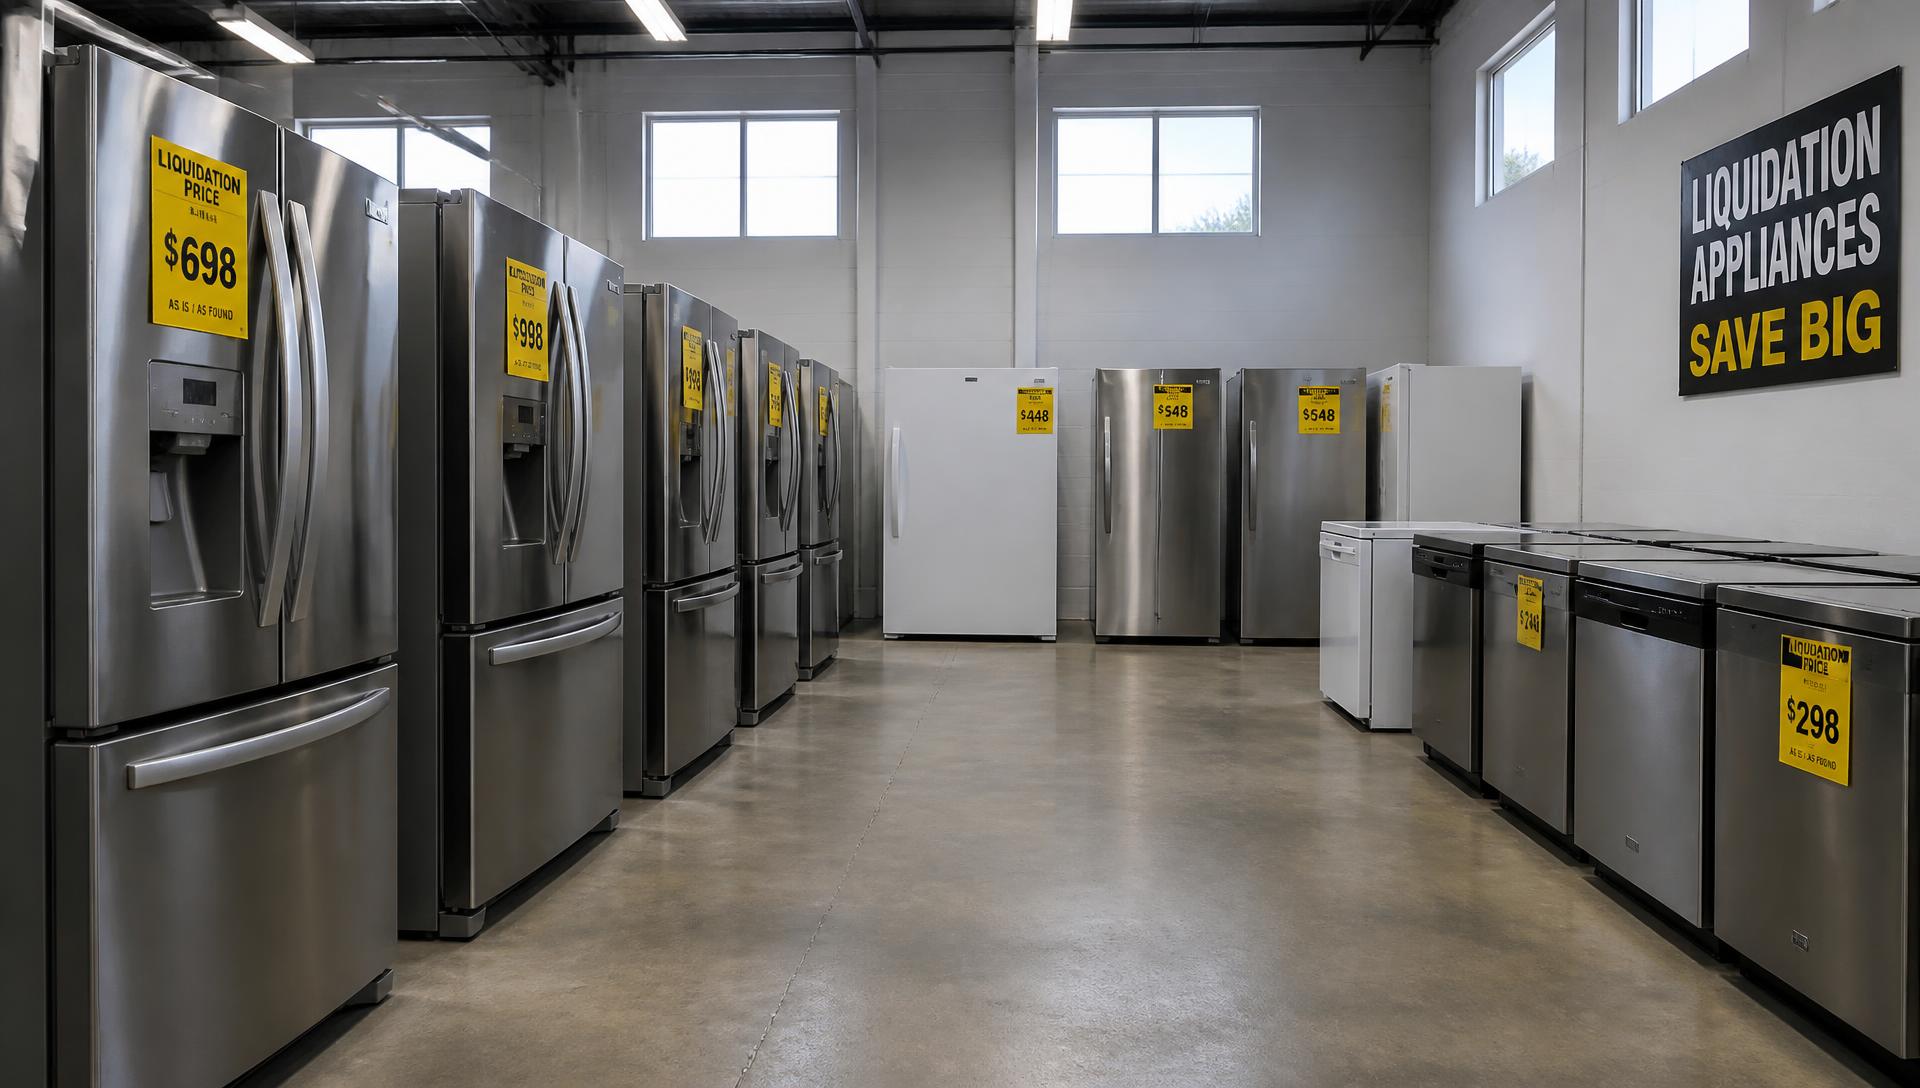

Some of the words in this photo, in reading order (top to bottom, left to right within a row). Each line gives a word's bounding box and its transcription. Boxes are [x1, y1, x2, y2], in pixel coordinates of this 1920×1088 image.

[158, 148, 241, 196] LIQUIDATION
[184, 178, 220, 207] PRICE
[1692, 104, 1881, 235] LIQUIDATION
[164, 227, 237, 289] $698
[1690, 192, 1881, 305] APPLIANCES
[168, 298, 180, 311] AS
[182, 300, 190, 313] IS
[196, 304, 207, 316] AS
[208, 306, 234, 321] FOUND
[1689, 307, 1786, 378] SAVE
[1801, 288, 1881, 362] BIG
[1020, 409, 1049, 422] $448
[1787, 695, 1839, 745] $298
